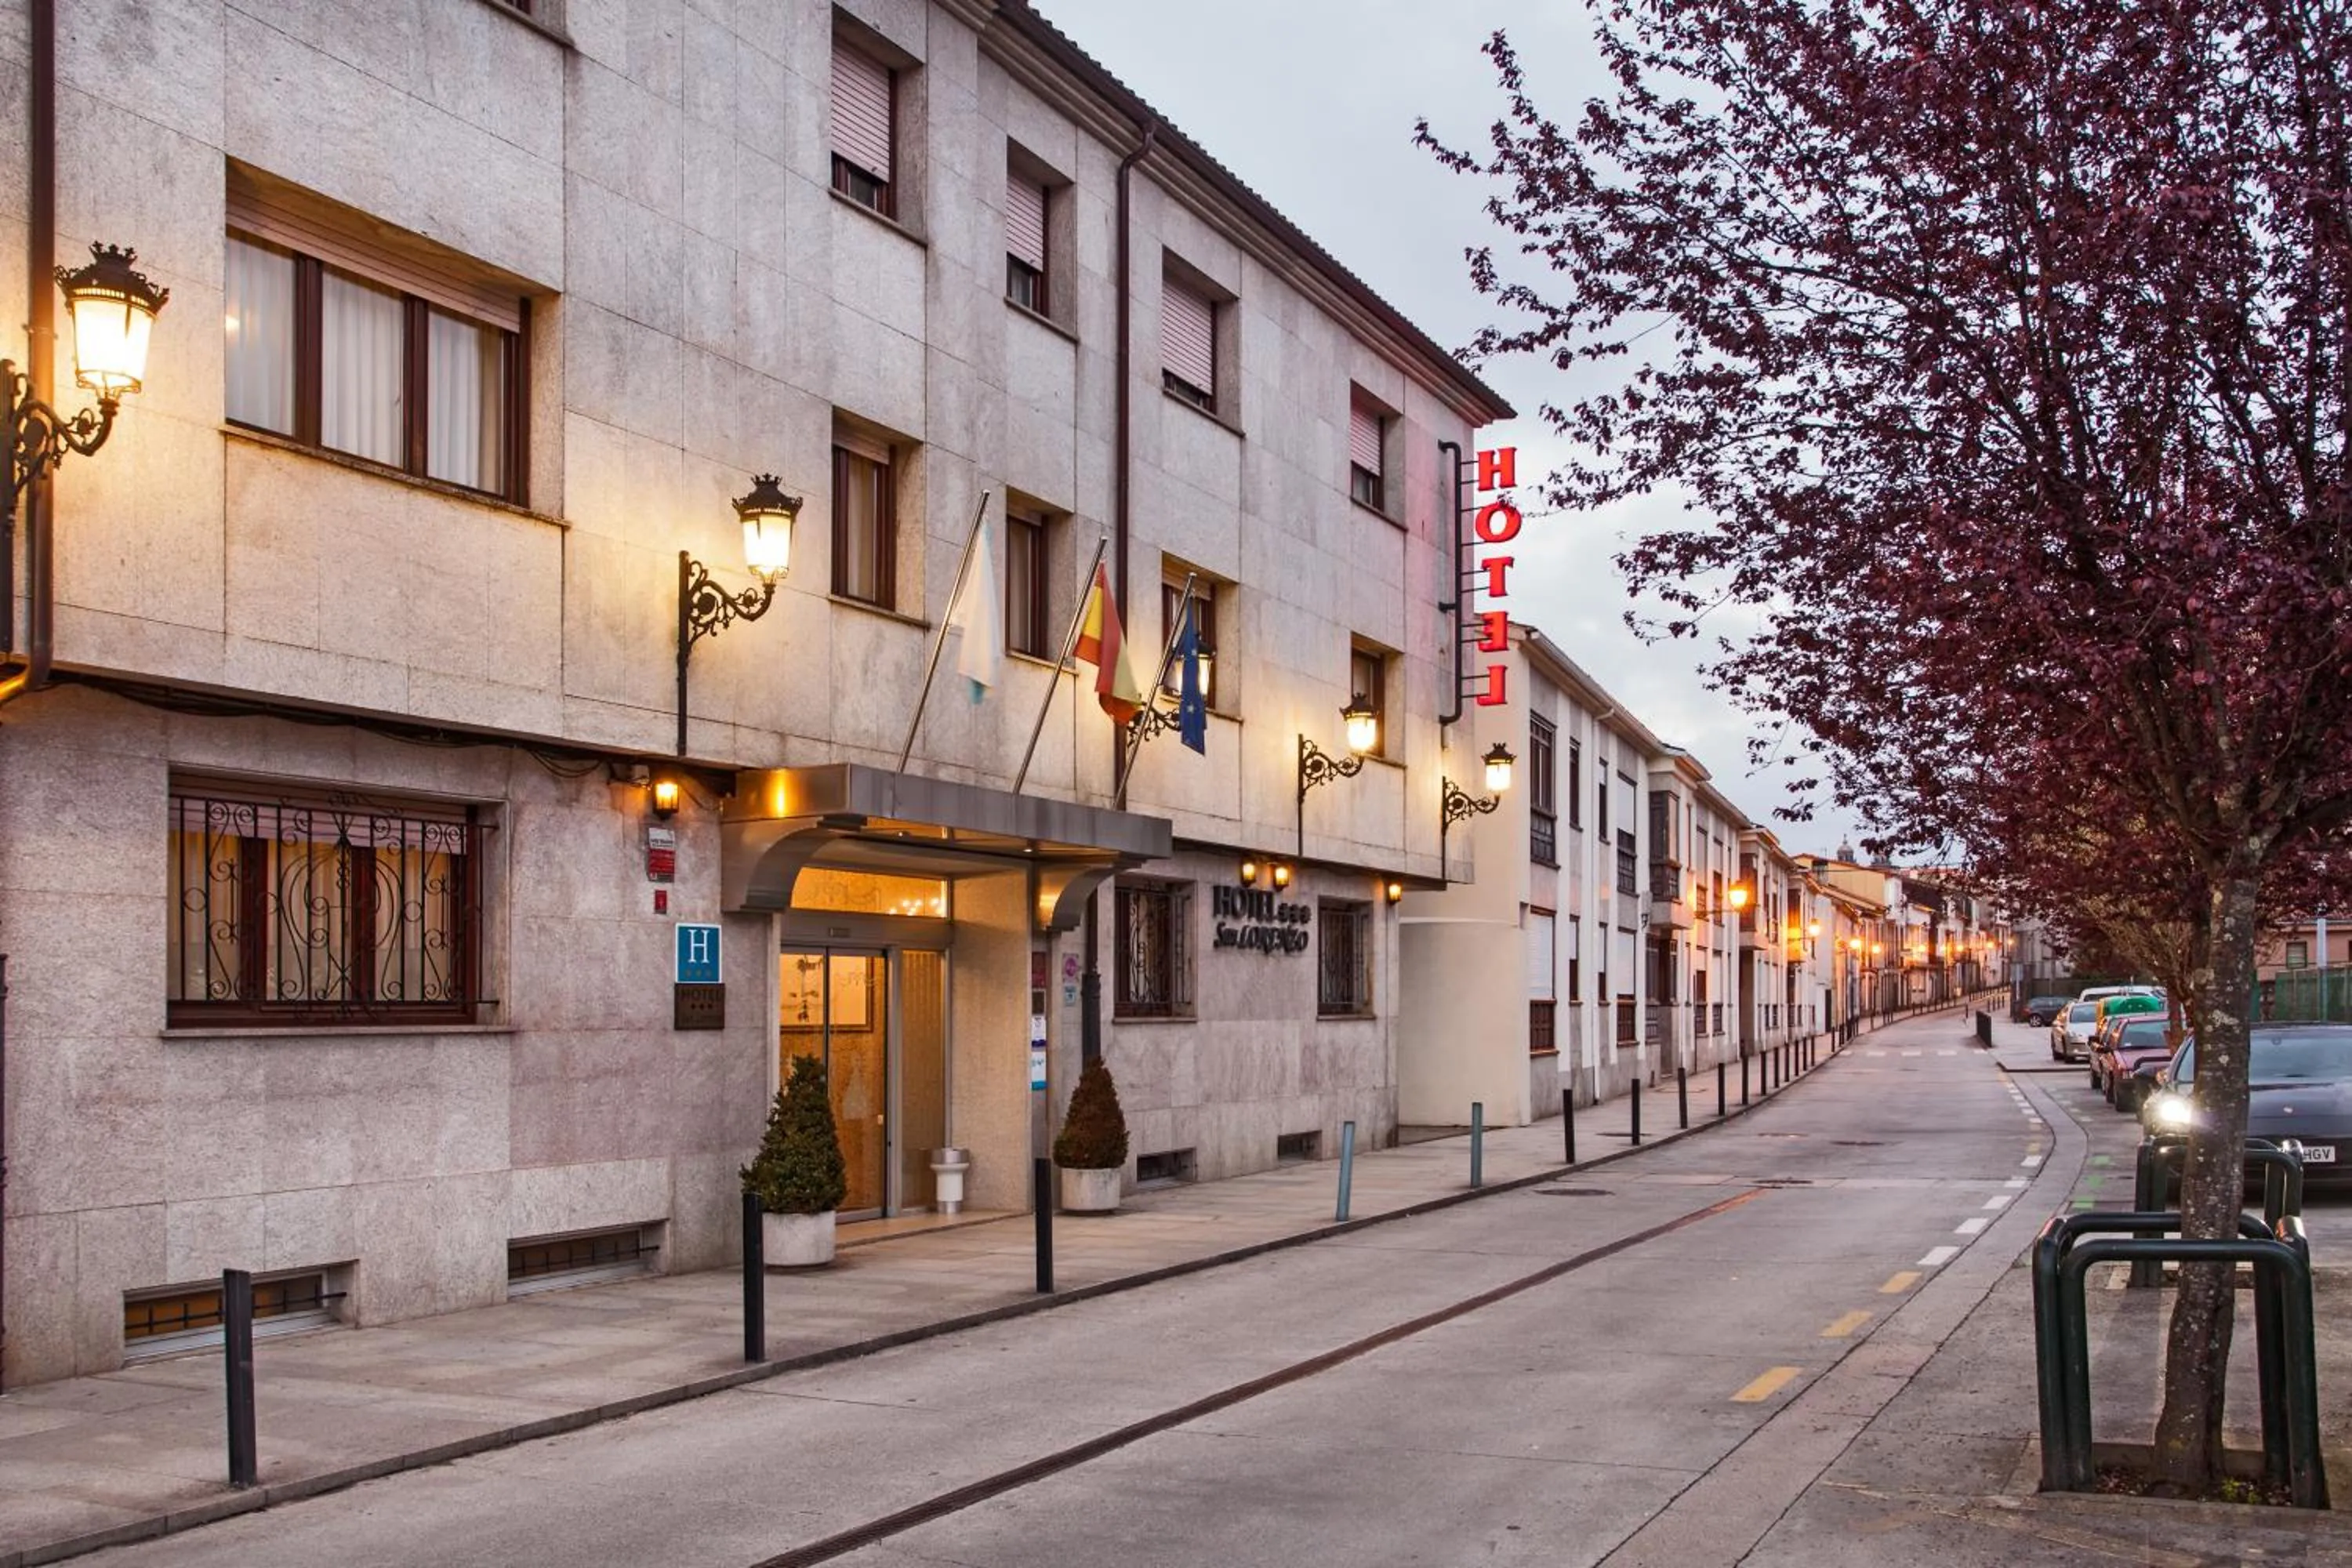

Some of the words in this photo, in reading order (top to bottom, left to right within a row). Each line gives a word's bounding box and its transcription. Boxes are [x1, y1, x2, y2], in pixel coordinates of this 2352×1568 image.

[1213, 885, 1274, 923] HOTEL
[688, 929, 710, 964] H
[681, 988, 721, 1002] HOTEL
